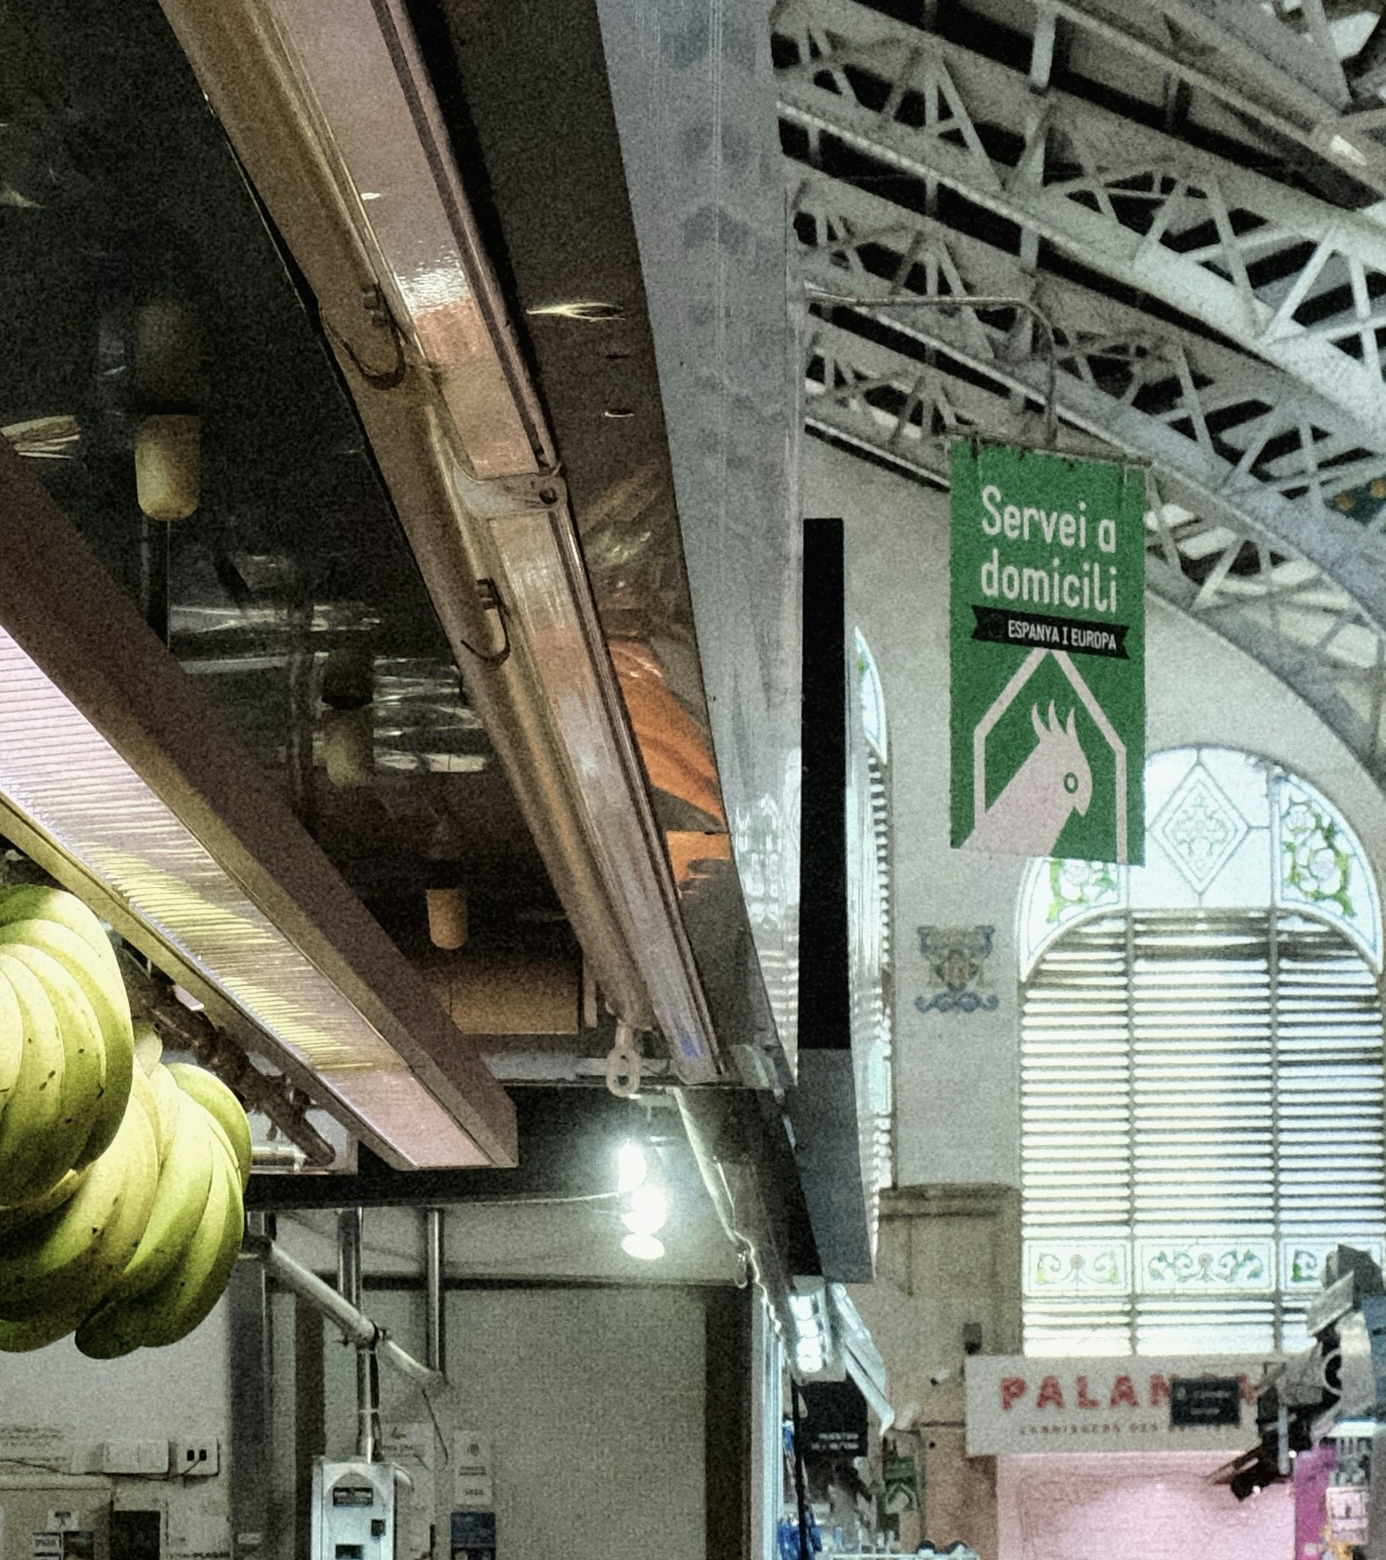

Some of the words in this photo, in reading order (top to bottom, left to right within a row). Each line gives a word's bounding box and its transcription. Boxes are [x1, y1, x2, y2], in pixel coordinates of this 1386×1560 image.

[981, 485, 1087, 549] Servei
[1097, 518, 1116, 554] a
[980, 547, 1118, 614] domicili
[1007, 620, 1060, 643] ESPANYA
[1061, 626, 1069, 646] I
[1070, 628, 1117, 651] EUROPA
